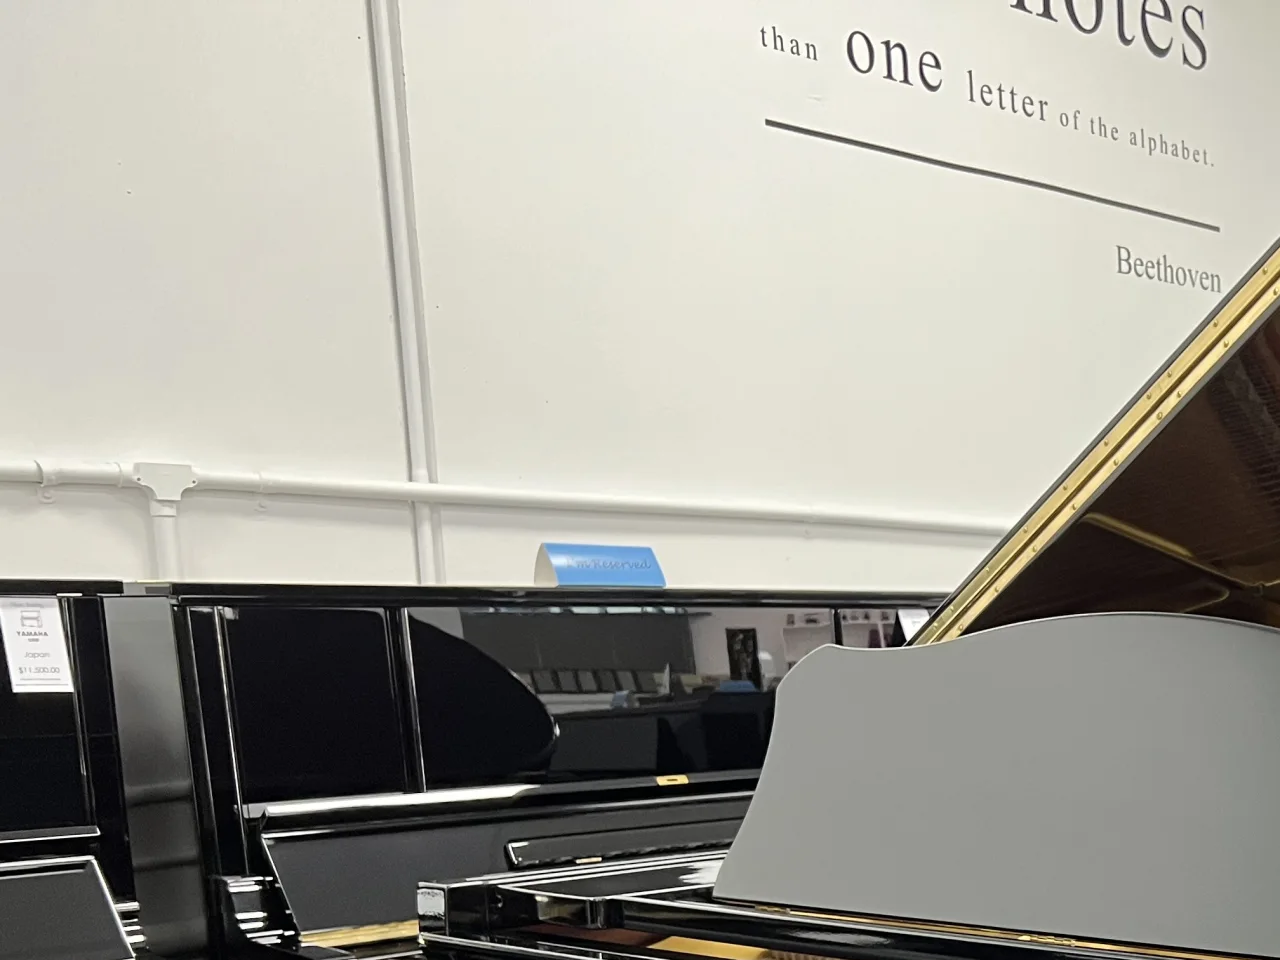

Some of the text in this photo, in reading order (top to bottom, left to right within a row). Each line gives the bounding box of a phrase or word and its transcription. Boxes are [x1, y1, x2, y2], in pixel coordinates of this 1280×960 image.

[760, 26, 1215, 168] than one letter of the alphabet.
[1116, 244, 1222, 294] Beethoven
[24, 651, 51, 659] Japan
